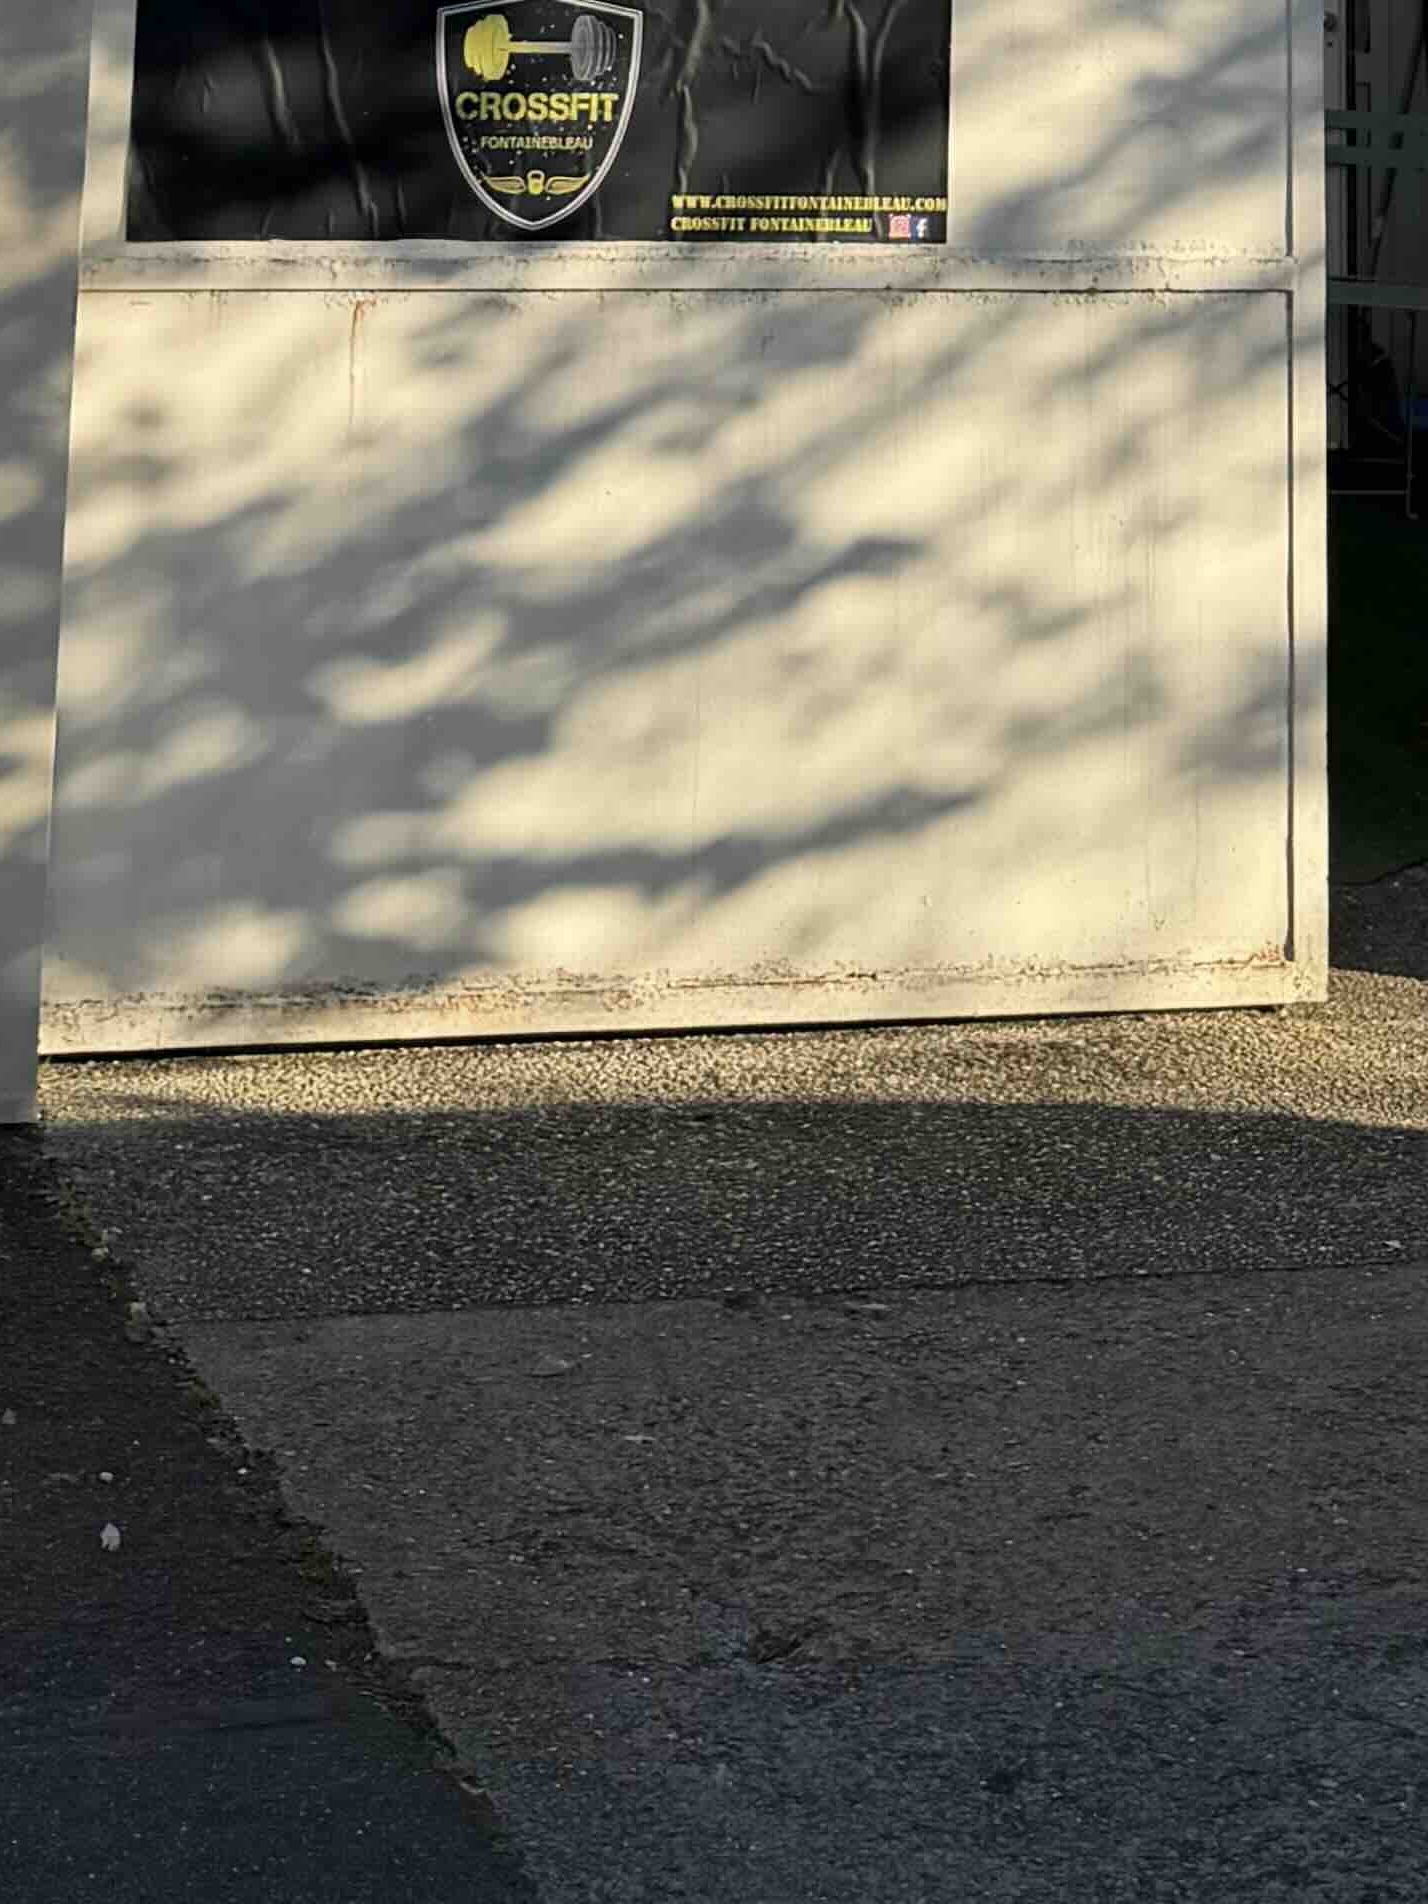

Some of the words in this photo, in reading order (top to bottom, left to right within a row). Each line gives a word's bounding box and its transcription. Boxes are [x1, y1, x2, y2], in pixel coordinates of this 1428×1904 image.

[454, 91, 620, 122] CROSSFIT
[480, 135, 594, 151] FONTAINEBLEAU
[670, 216, 746, 232] CROSSFIT
[750, 217, 873, 233] FONTAINEBLEAU
